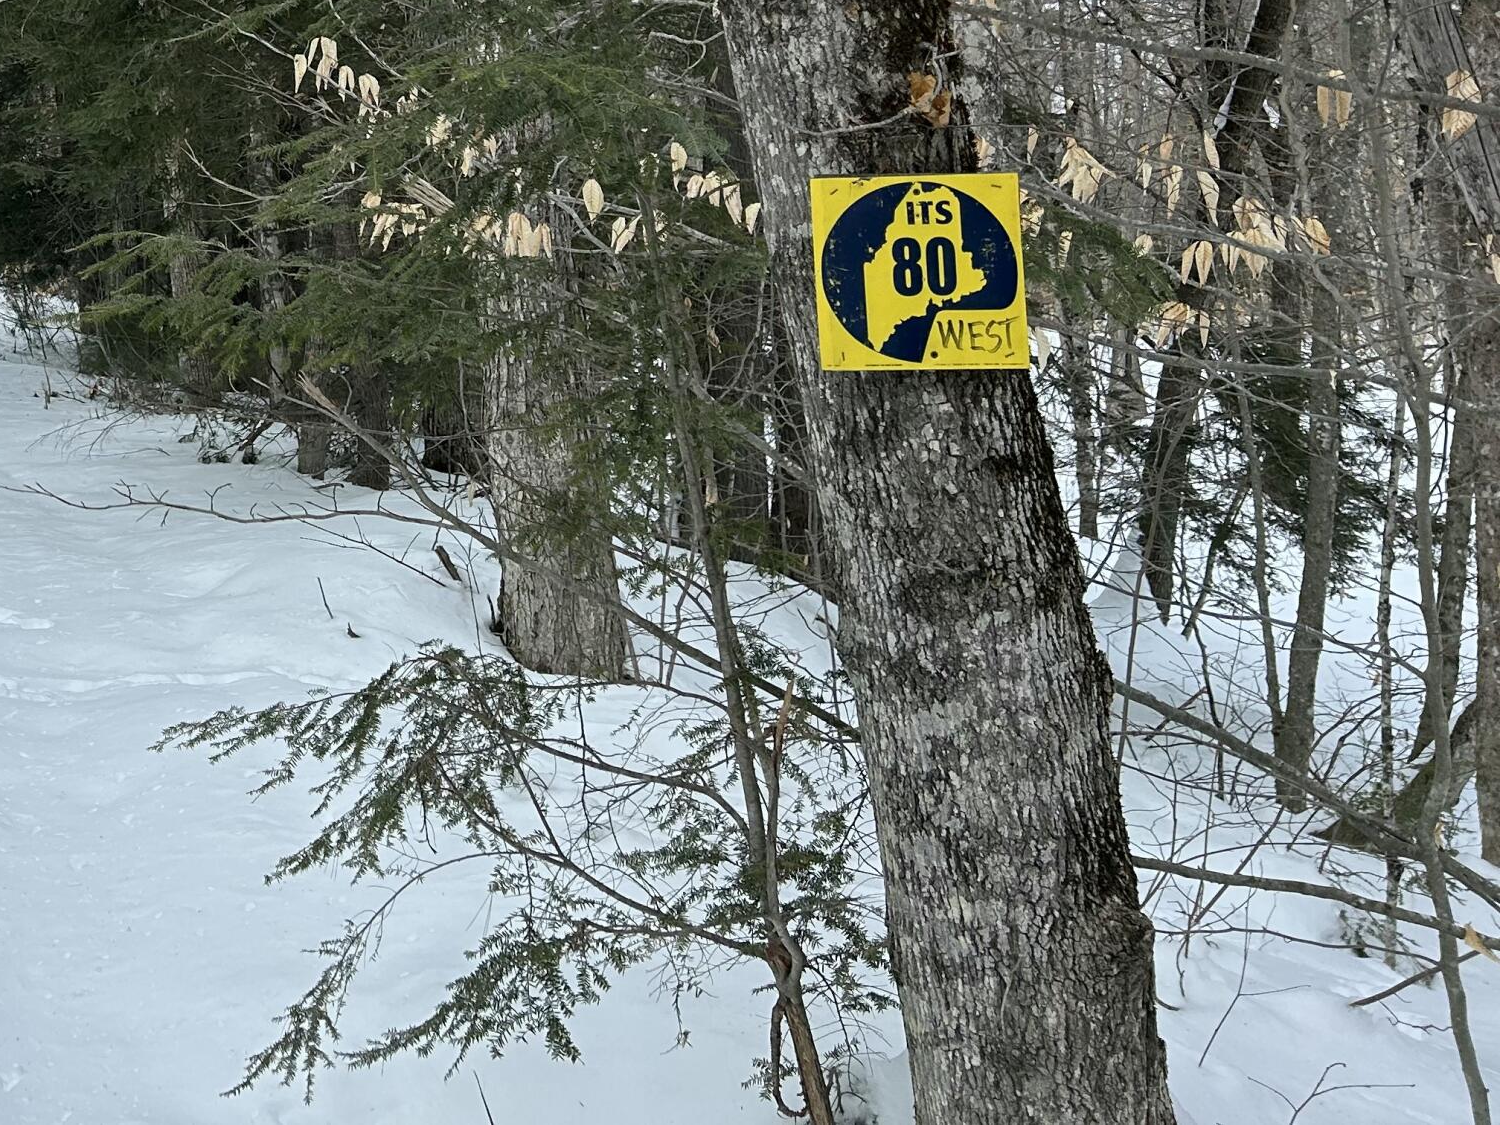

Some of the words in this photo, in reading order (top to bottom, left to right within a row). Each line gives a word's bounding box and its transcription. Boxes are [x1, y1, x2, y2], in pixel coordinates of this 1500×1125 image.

[906, 200, 953, 225] ITS
[892, 236, 958, 296] 80
[937, 316, 1020, 353] WEST
